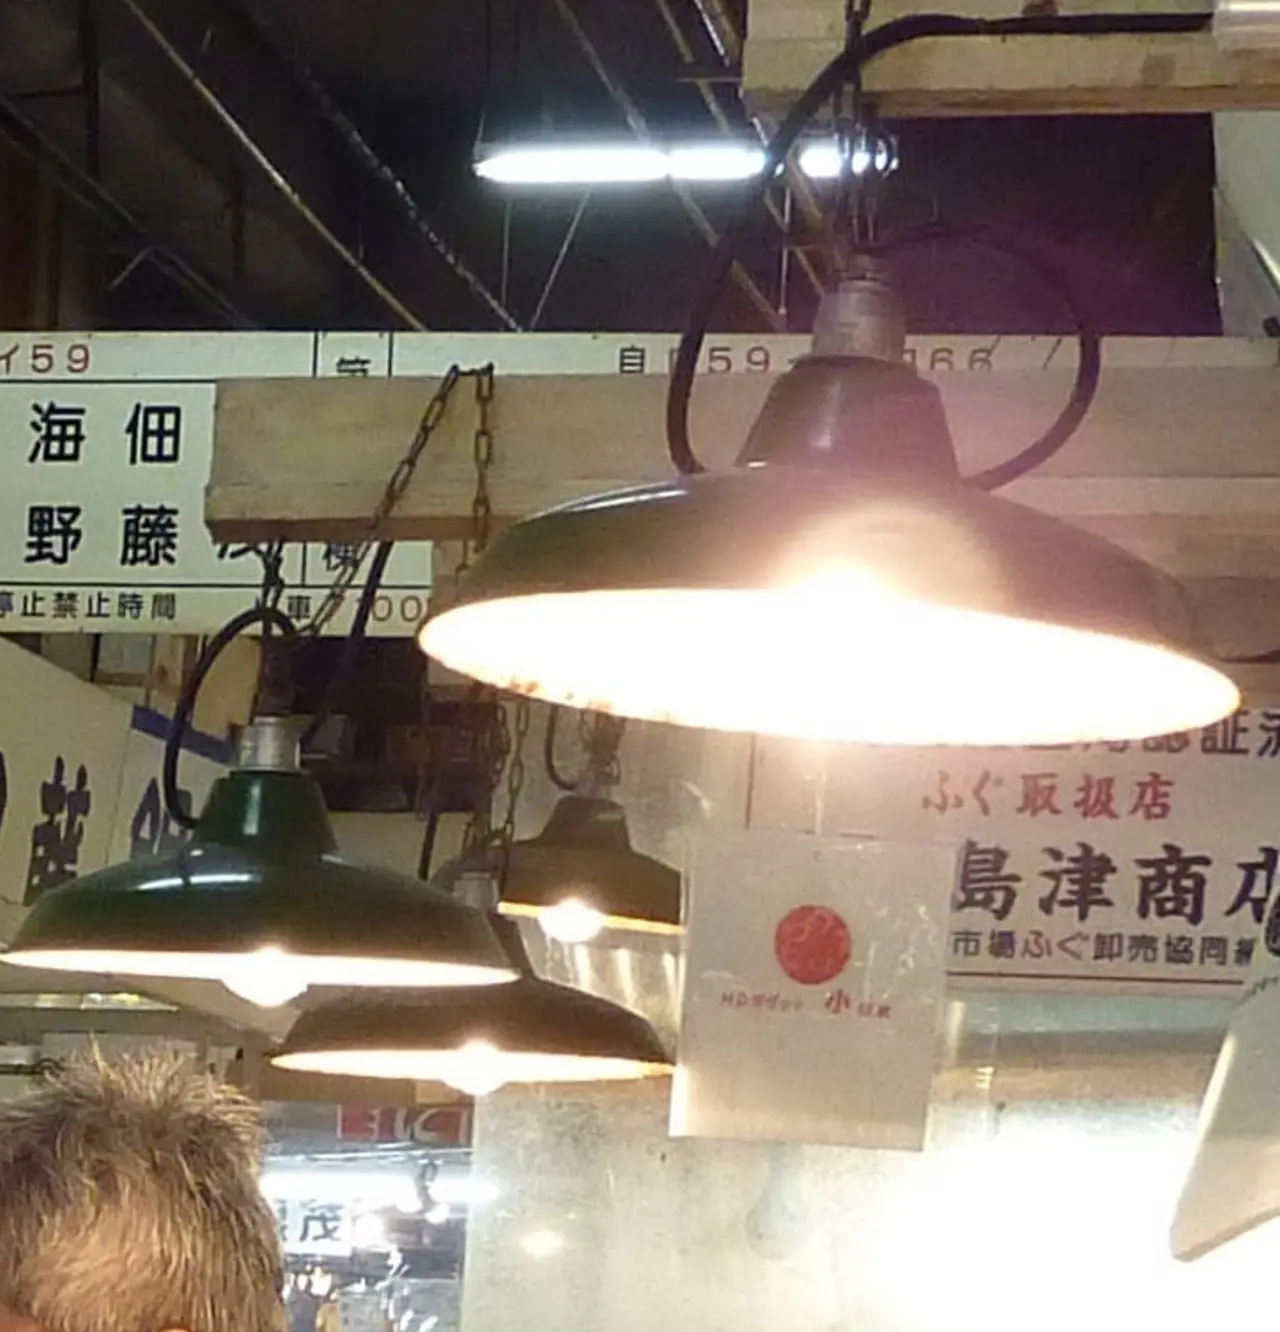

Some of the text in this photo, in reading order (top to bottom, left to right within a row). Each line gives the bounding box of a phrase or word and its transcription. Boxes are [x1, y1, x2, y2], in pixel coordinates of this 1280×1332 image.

[24, 402, 86, 566] 海野
[120, 403, 182, 566] 佃藤
[922, 770, 1174, 821] ふぐ取扱店
